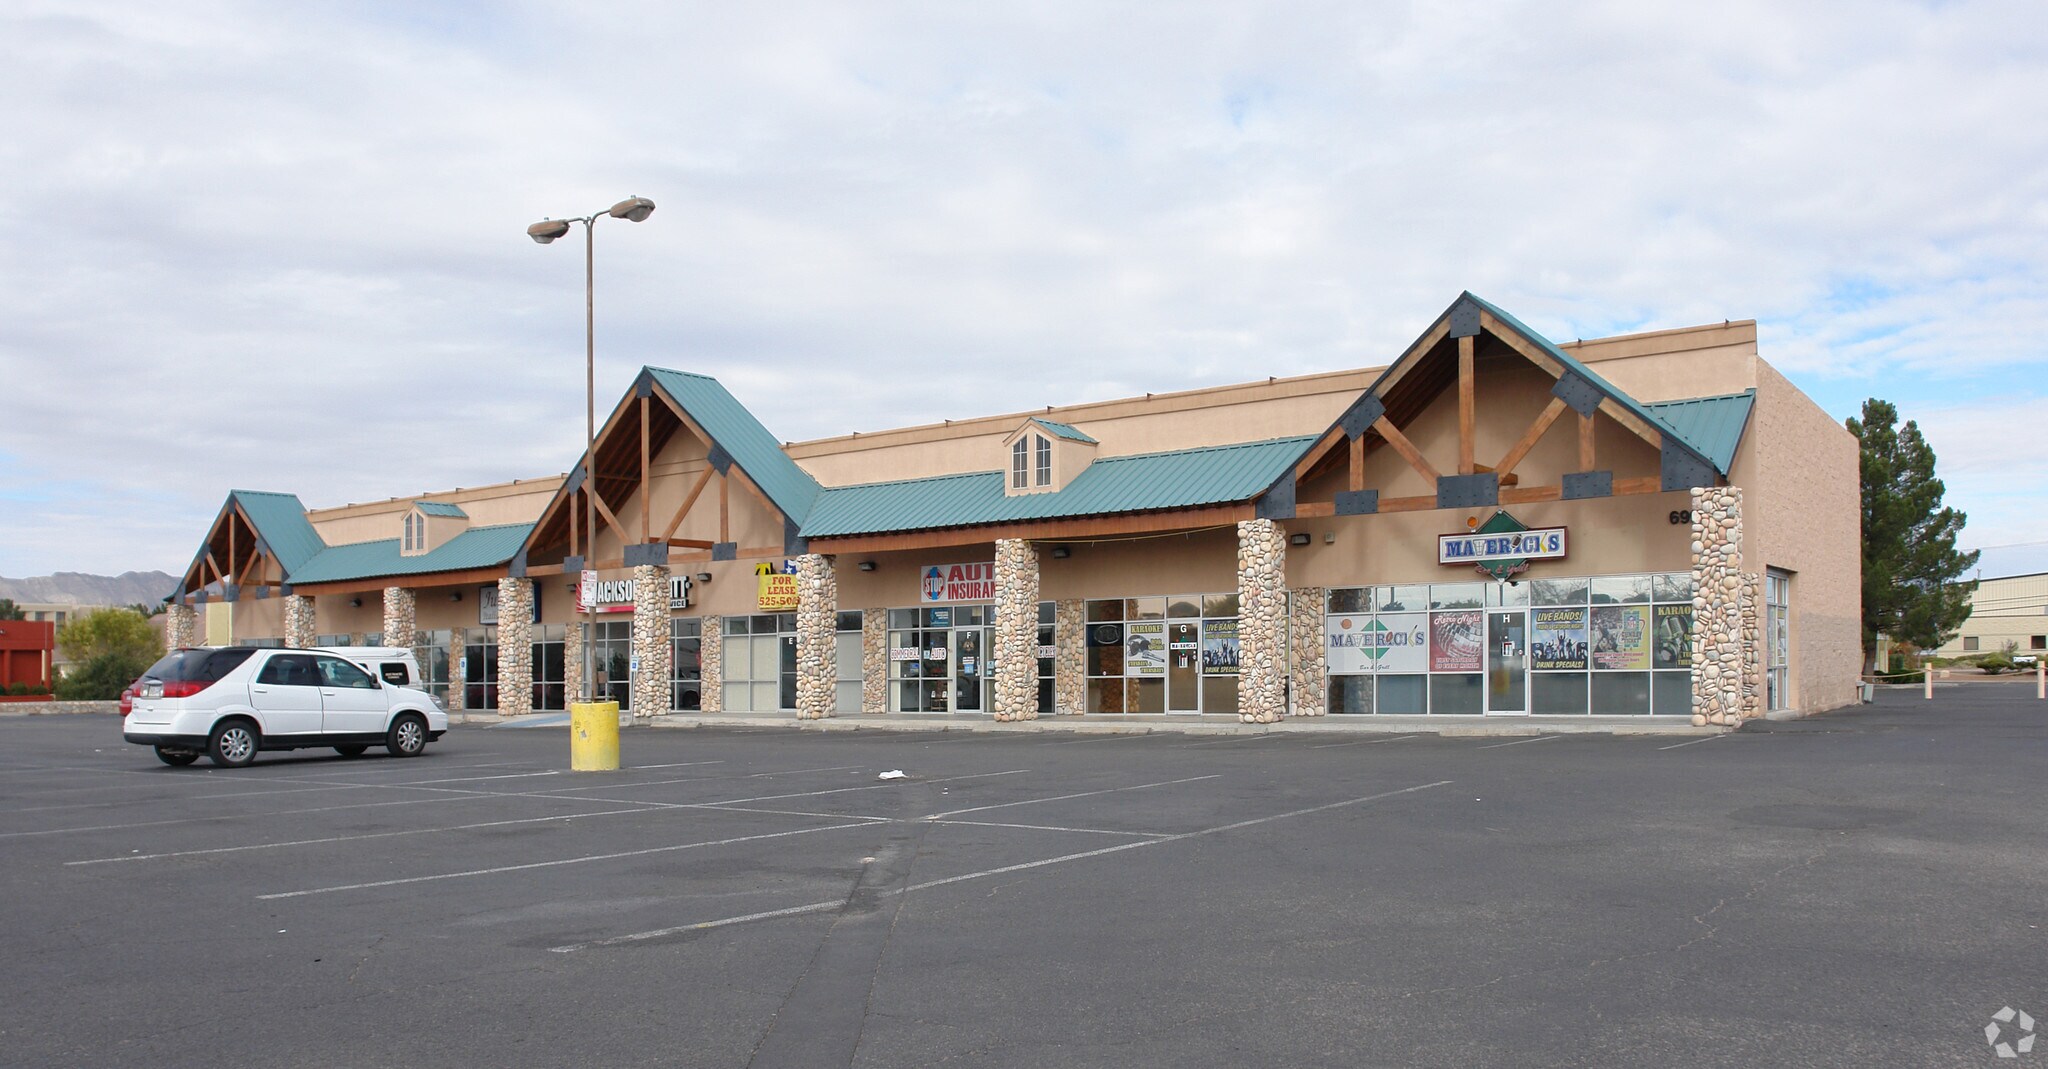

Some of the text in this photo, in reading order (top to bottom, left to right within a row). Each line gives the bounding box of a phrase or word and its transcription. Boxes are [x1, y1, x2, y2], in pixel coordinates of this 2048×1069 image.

[1446, 533, 1560, 557] MAVERICKS
[948, 564, 995, 581] AUT
[1496, 564, 1503, 574] &
[1507, 563, 1530, 575] Grill
[772, 576, 791, 585] FOR
[925, 577, 943, 593] STOP
[597, 579, 635, 603] ACKSO
[768, 586, 795, 595] LEASE
[948, 581, 996, 600] INSURAN
[1537, 611, 1583, 622] LIVE BANDS!
[1658, 606, 1692, 616] KARAO
[1434, 614, 1480, 625] Retro Night
[1503, 614, 1510, 623] H
[1206, 624, 1218, 632] LIVE
[930, 647, 946, 660] AUTO
[1556, 660, 1584, 668] SPECIALS!
